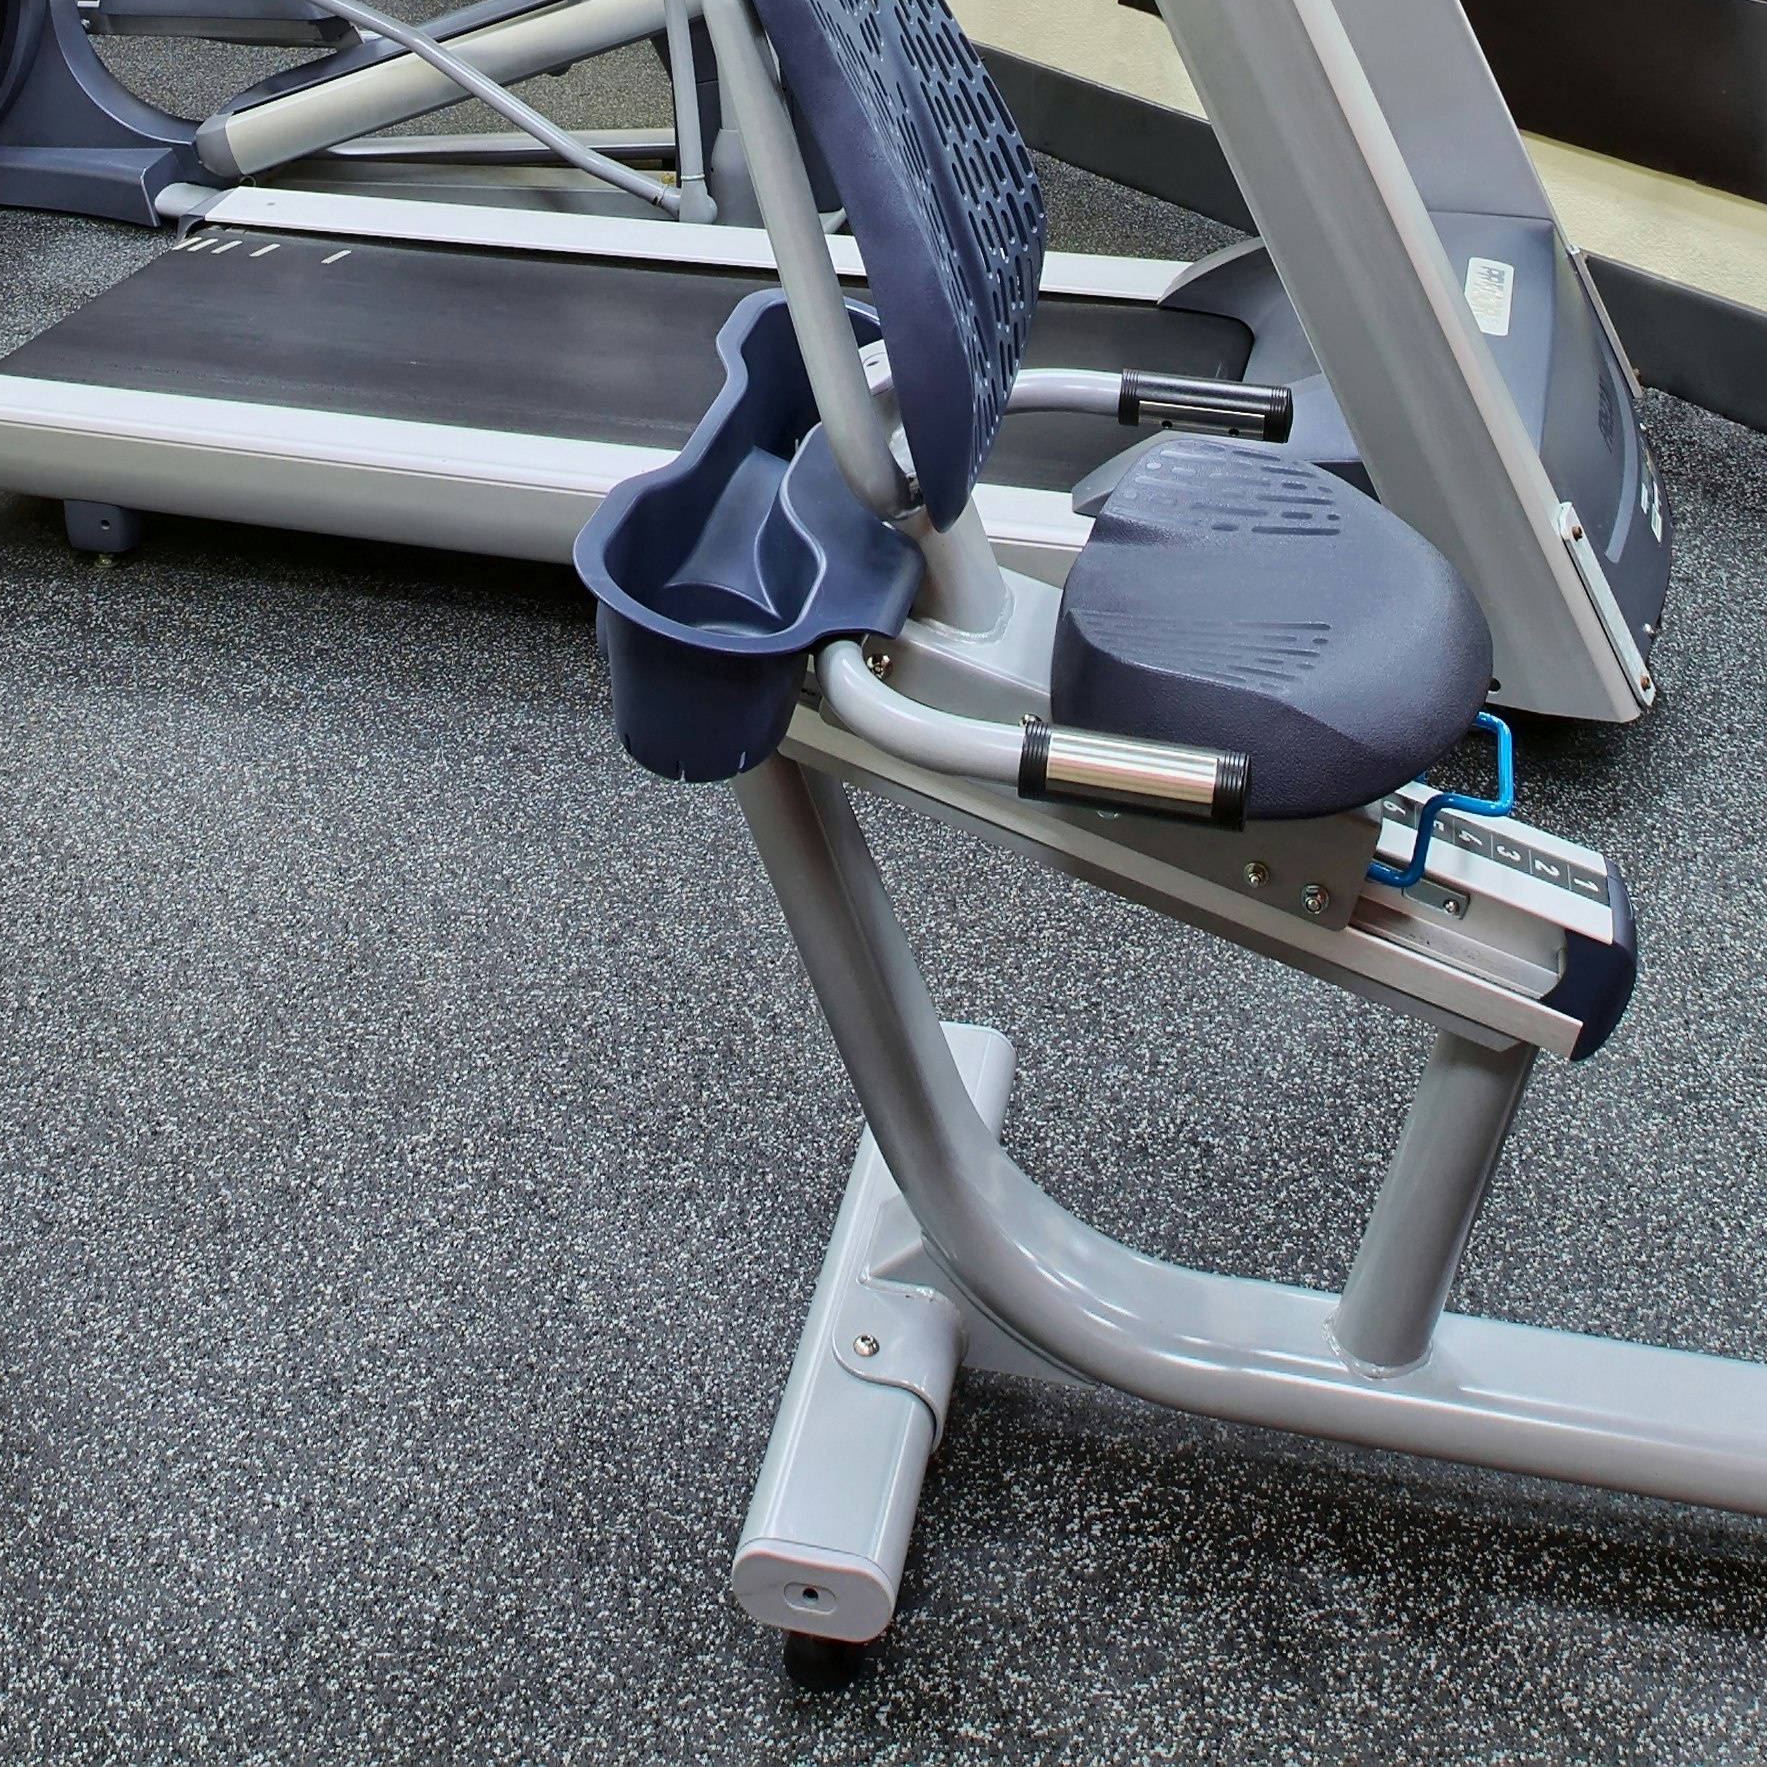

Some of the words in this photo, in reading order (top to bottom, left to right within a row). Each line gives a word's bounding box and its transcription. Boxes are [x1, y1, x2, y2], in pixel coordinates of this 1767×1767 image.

[1383, 801, 1407, 816] 6
[1458, 830, 1483, 846] 4
[1496, 845, 1521, 862] 3
[1534, 859, 1560, 877] 2
[1574, 877, 1599, 893] 1
